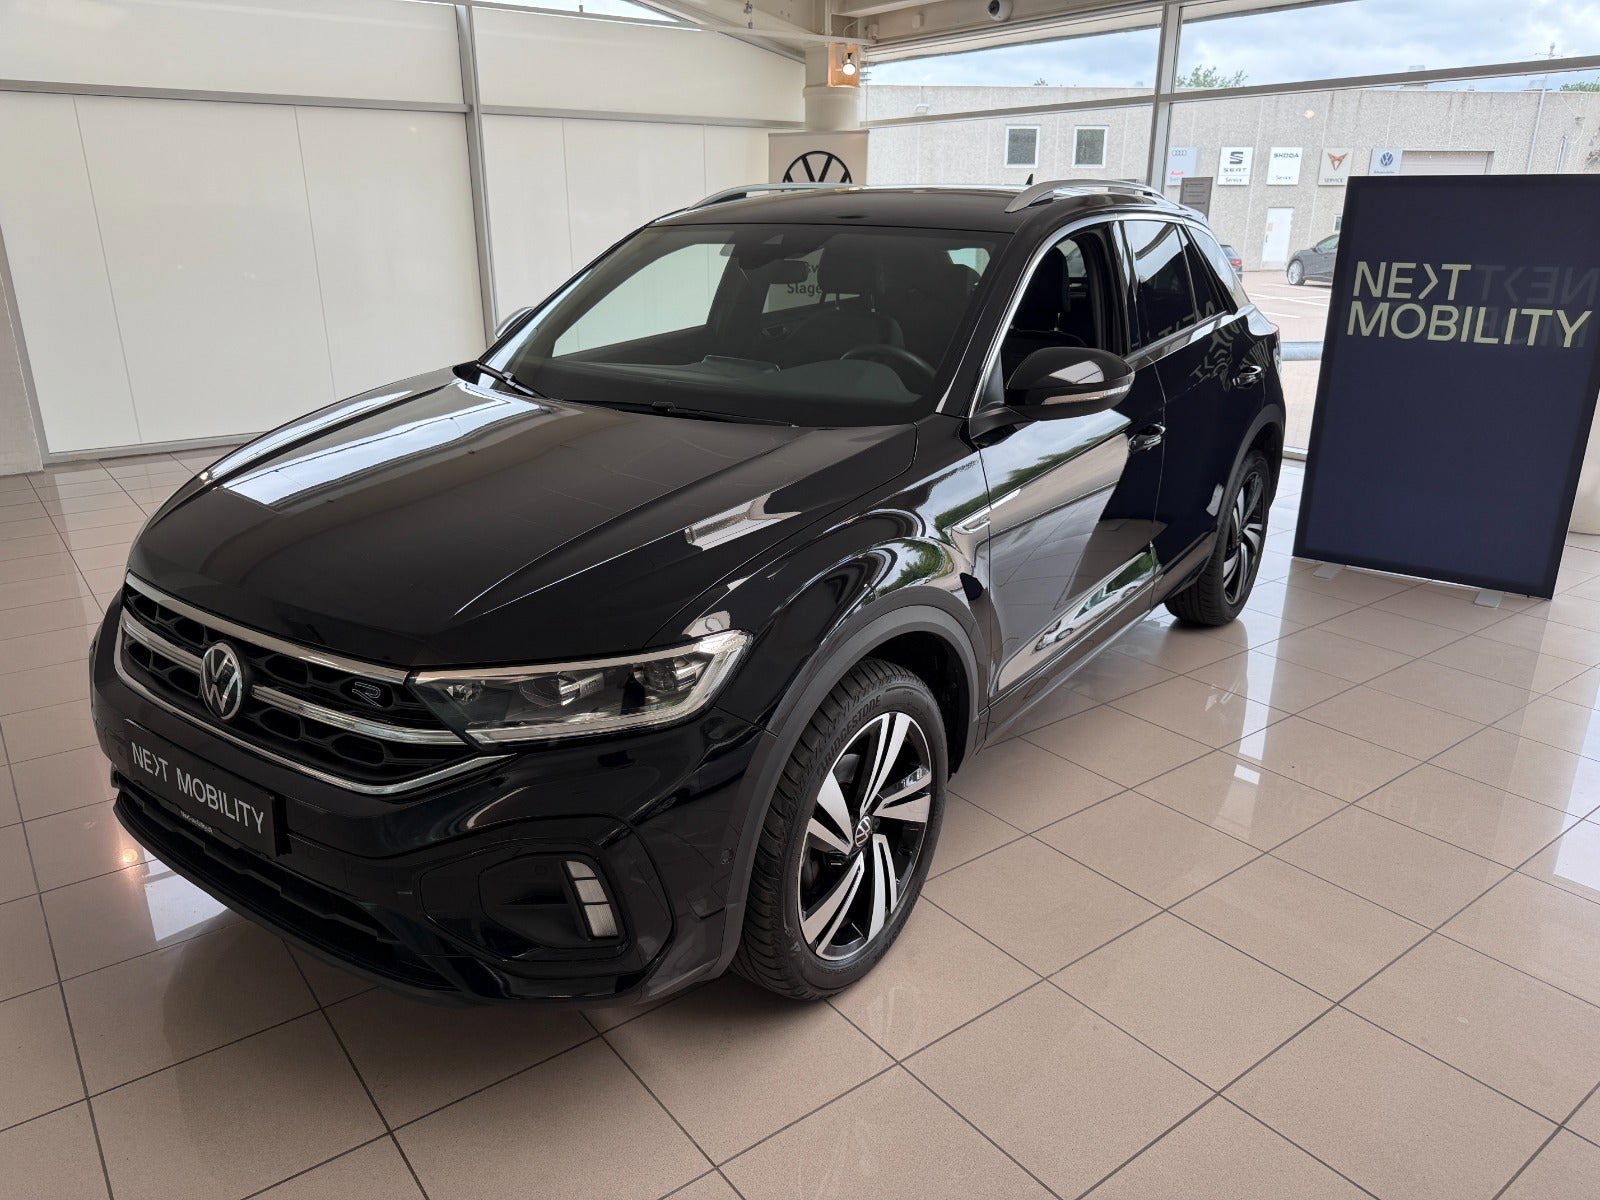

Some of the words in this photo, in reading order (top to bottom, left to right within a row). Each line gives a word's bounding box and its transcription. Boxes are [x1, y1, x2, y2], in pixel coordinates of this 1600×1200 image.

[787, 283, 822, 297] Slage
[1346, 300, 1593, 348] MOBILITY
[176, 767, 265, 834] MOBILITY
